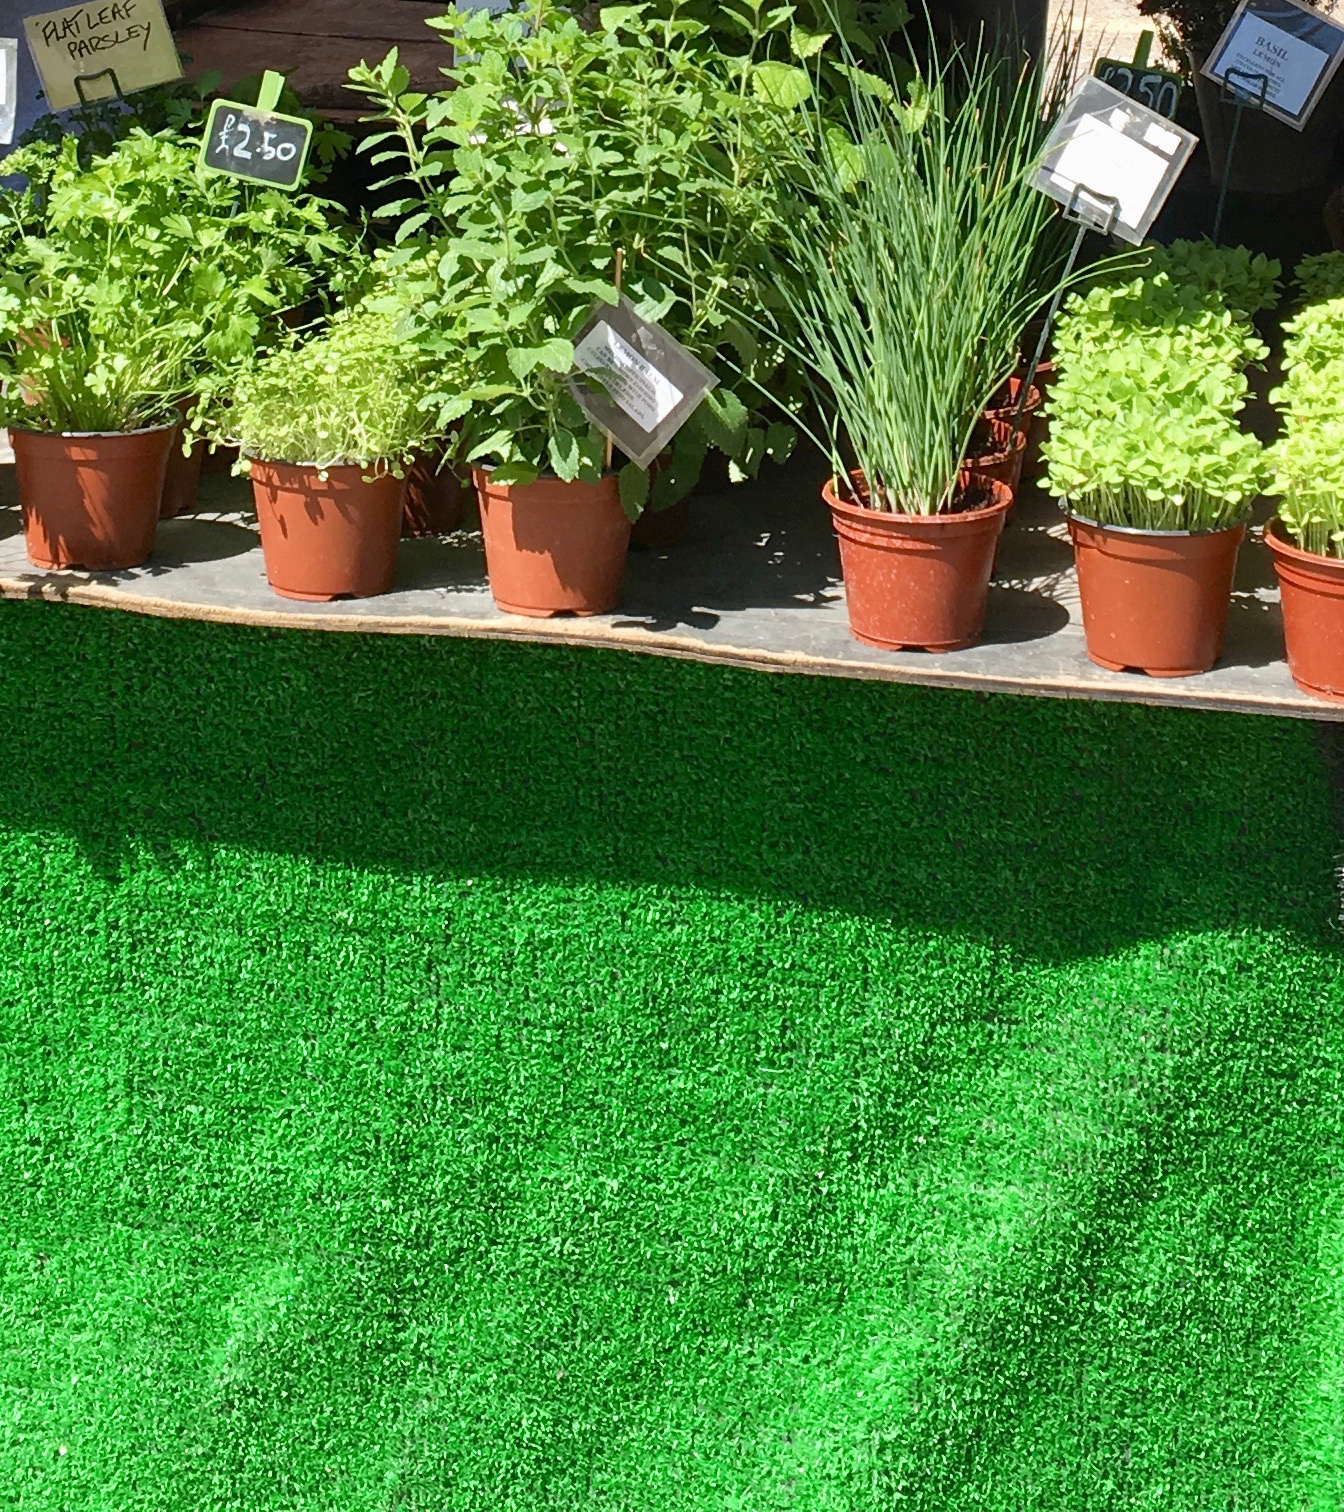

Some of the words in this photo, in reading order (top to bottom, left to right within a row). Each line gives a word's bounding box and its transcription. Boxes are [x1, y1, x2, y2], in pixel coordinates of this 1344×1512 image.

[67, 21, 151, 61] PARSLEY
[1255, 35, 1291, 62] BASIL
[1252, 48, 1282, 69] LEMON
[215, 114, 297, 161] £2.50
